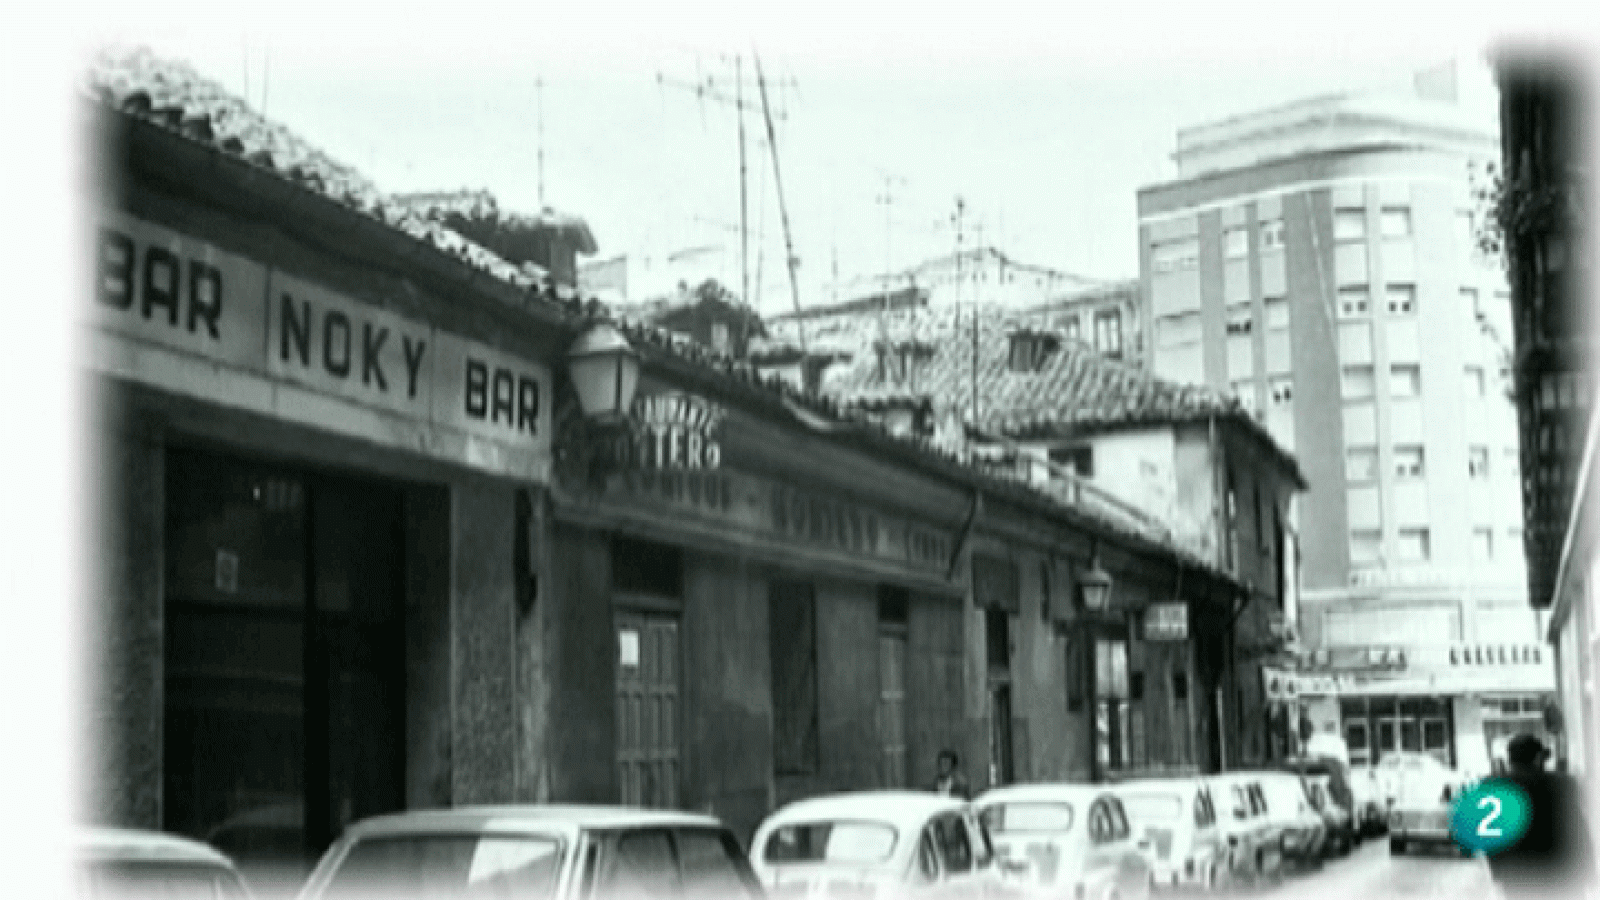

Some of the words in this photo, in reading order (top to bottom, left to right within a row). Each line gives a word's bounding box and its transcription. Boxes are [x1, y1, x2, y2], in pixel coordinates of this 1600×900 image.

[97, 230, 222, 340] BAR
[280, 293, 426, 400] NOKY
[465, 356, 540, 436] BAR
